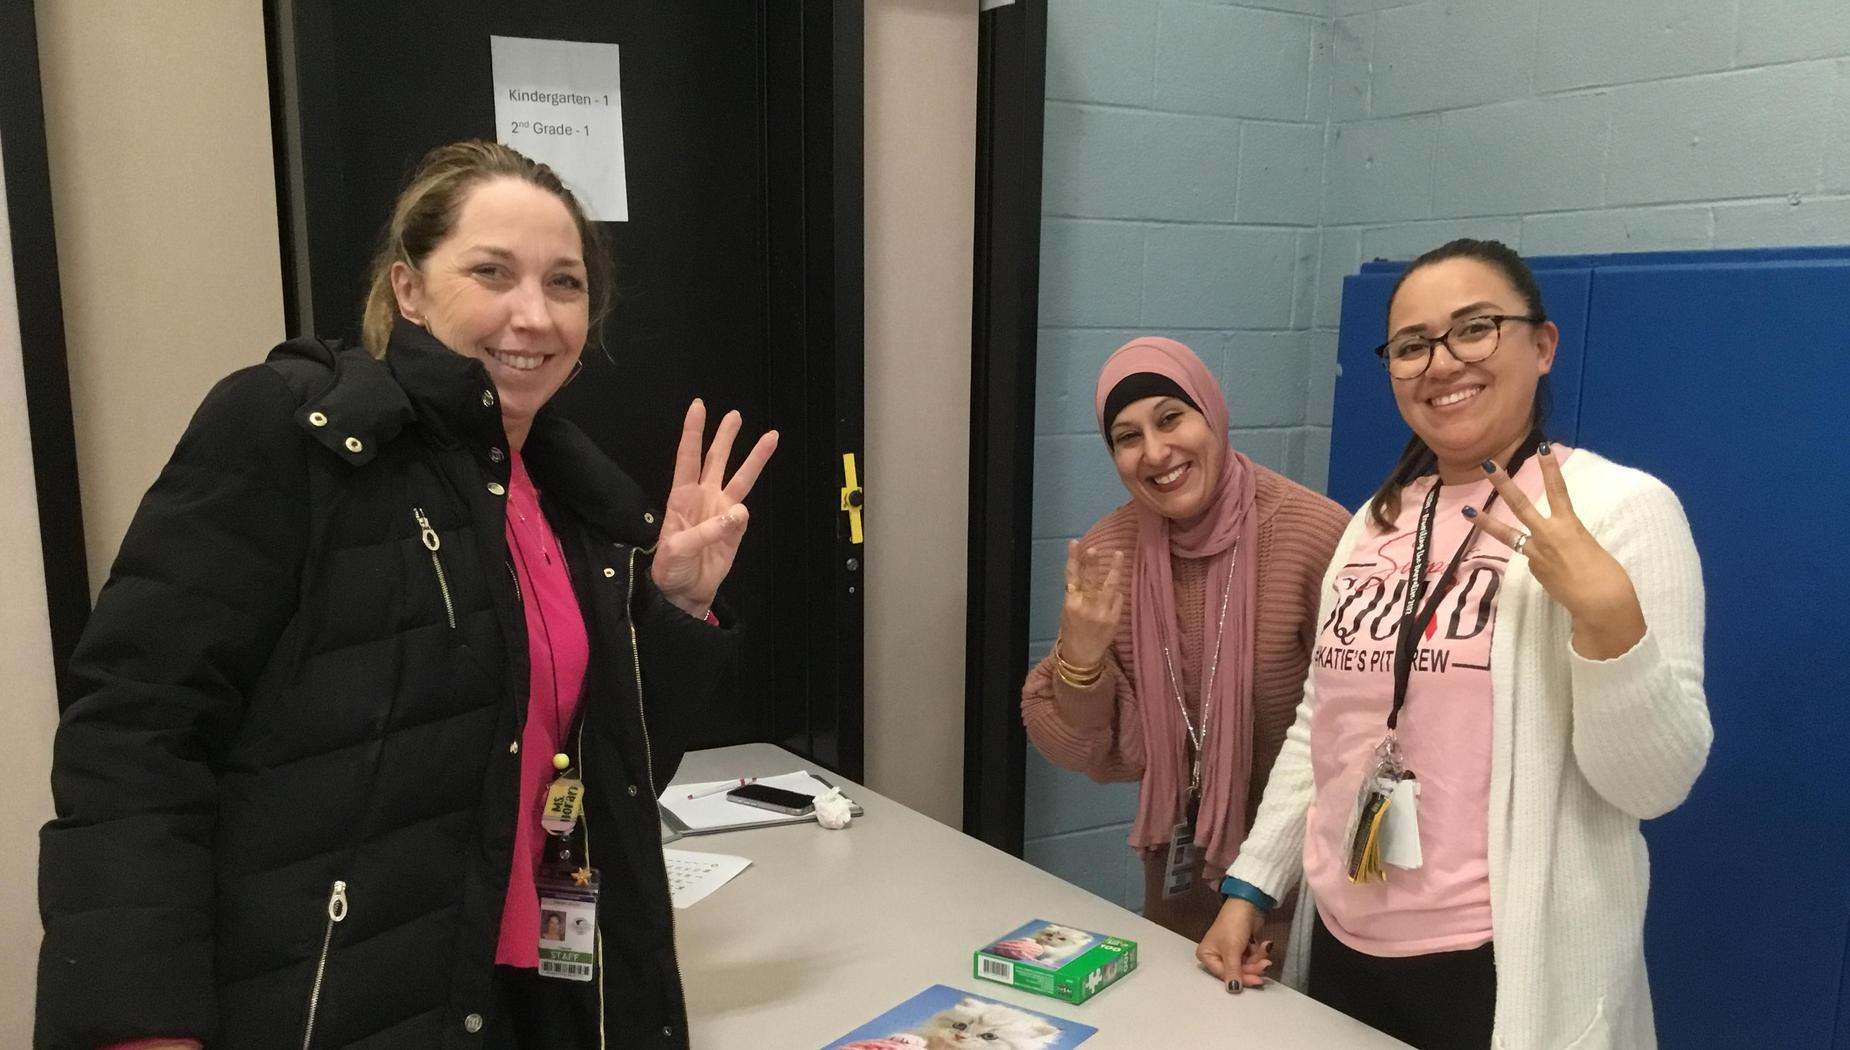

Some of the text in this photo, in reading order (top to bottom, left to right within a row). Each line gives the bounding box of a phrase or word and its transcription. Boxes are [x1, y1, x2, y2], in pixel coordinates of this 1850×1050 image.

[508, 88, 592, 107] Kindergarten
[602, 94, 610, 107] 1
[511, 121, 530, 134] 2nd
[532, 121, 573, 136] Grade
[583, 124, 590, 137] 1
[1370, 650, 1395, 673] PIT
[1410, 648, 1450, 673] REW
[550, 950, 580, 961] STAFF
